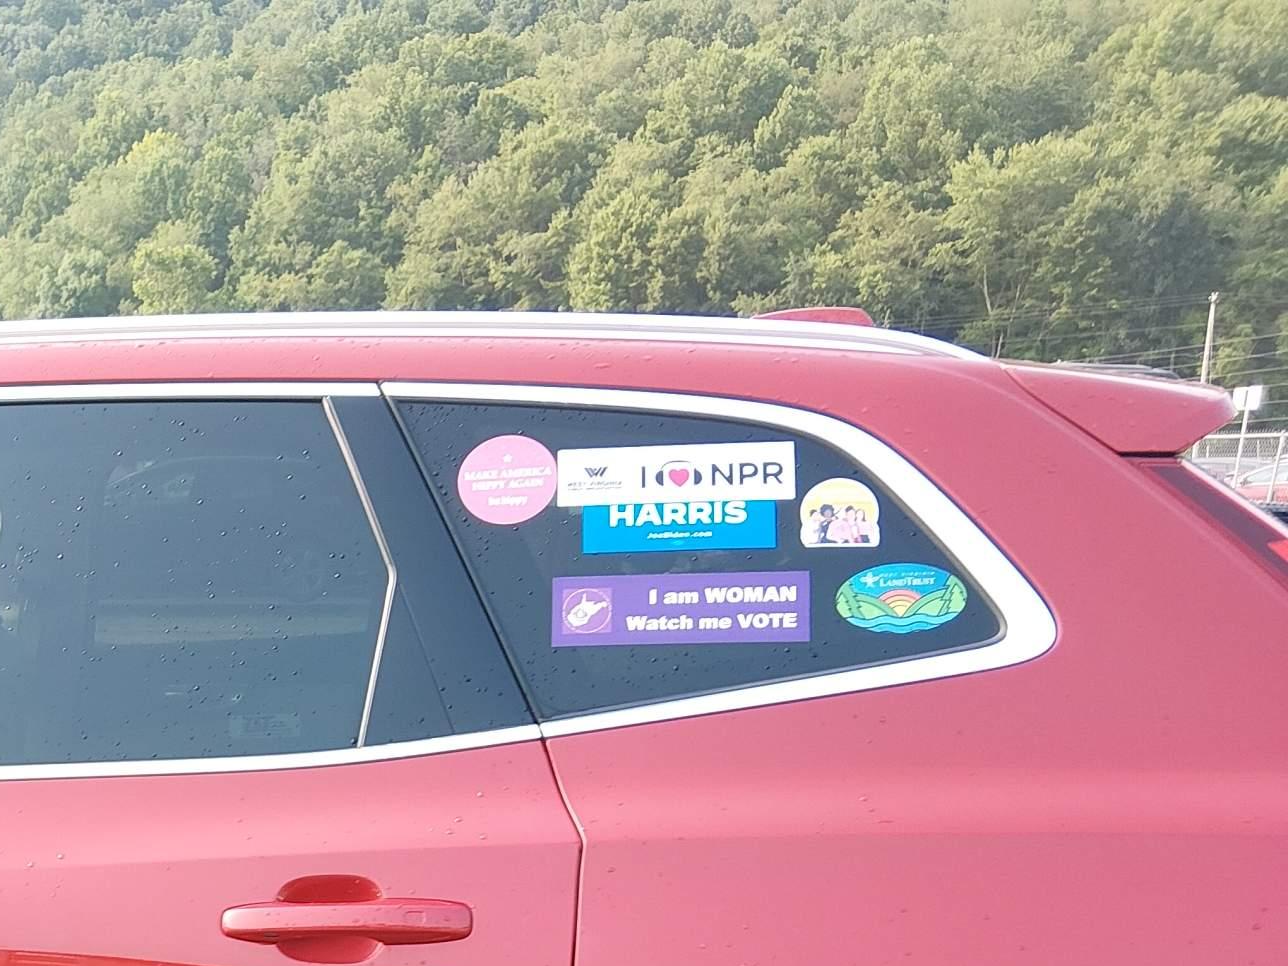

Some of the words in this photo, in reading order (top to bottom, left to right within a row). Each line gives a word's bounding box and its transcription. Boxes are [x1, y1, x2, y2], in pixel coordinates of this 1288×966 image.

[641, 466, 646, 489] I
[711, 462, 783, 486] NPR
[609, 501, 748, 528] HARRIS
[648, 588, 658, 605] I
[663, 591, 699, 605] am
[704, 585, 797, 604] WOMAN
[625, 614, 694, 631] Watch
[698, 616, 733, 630] me
[736, 612, 798, 629] VOTE
